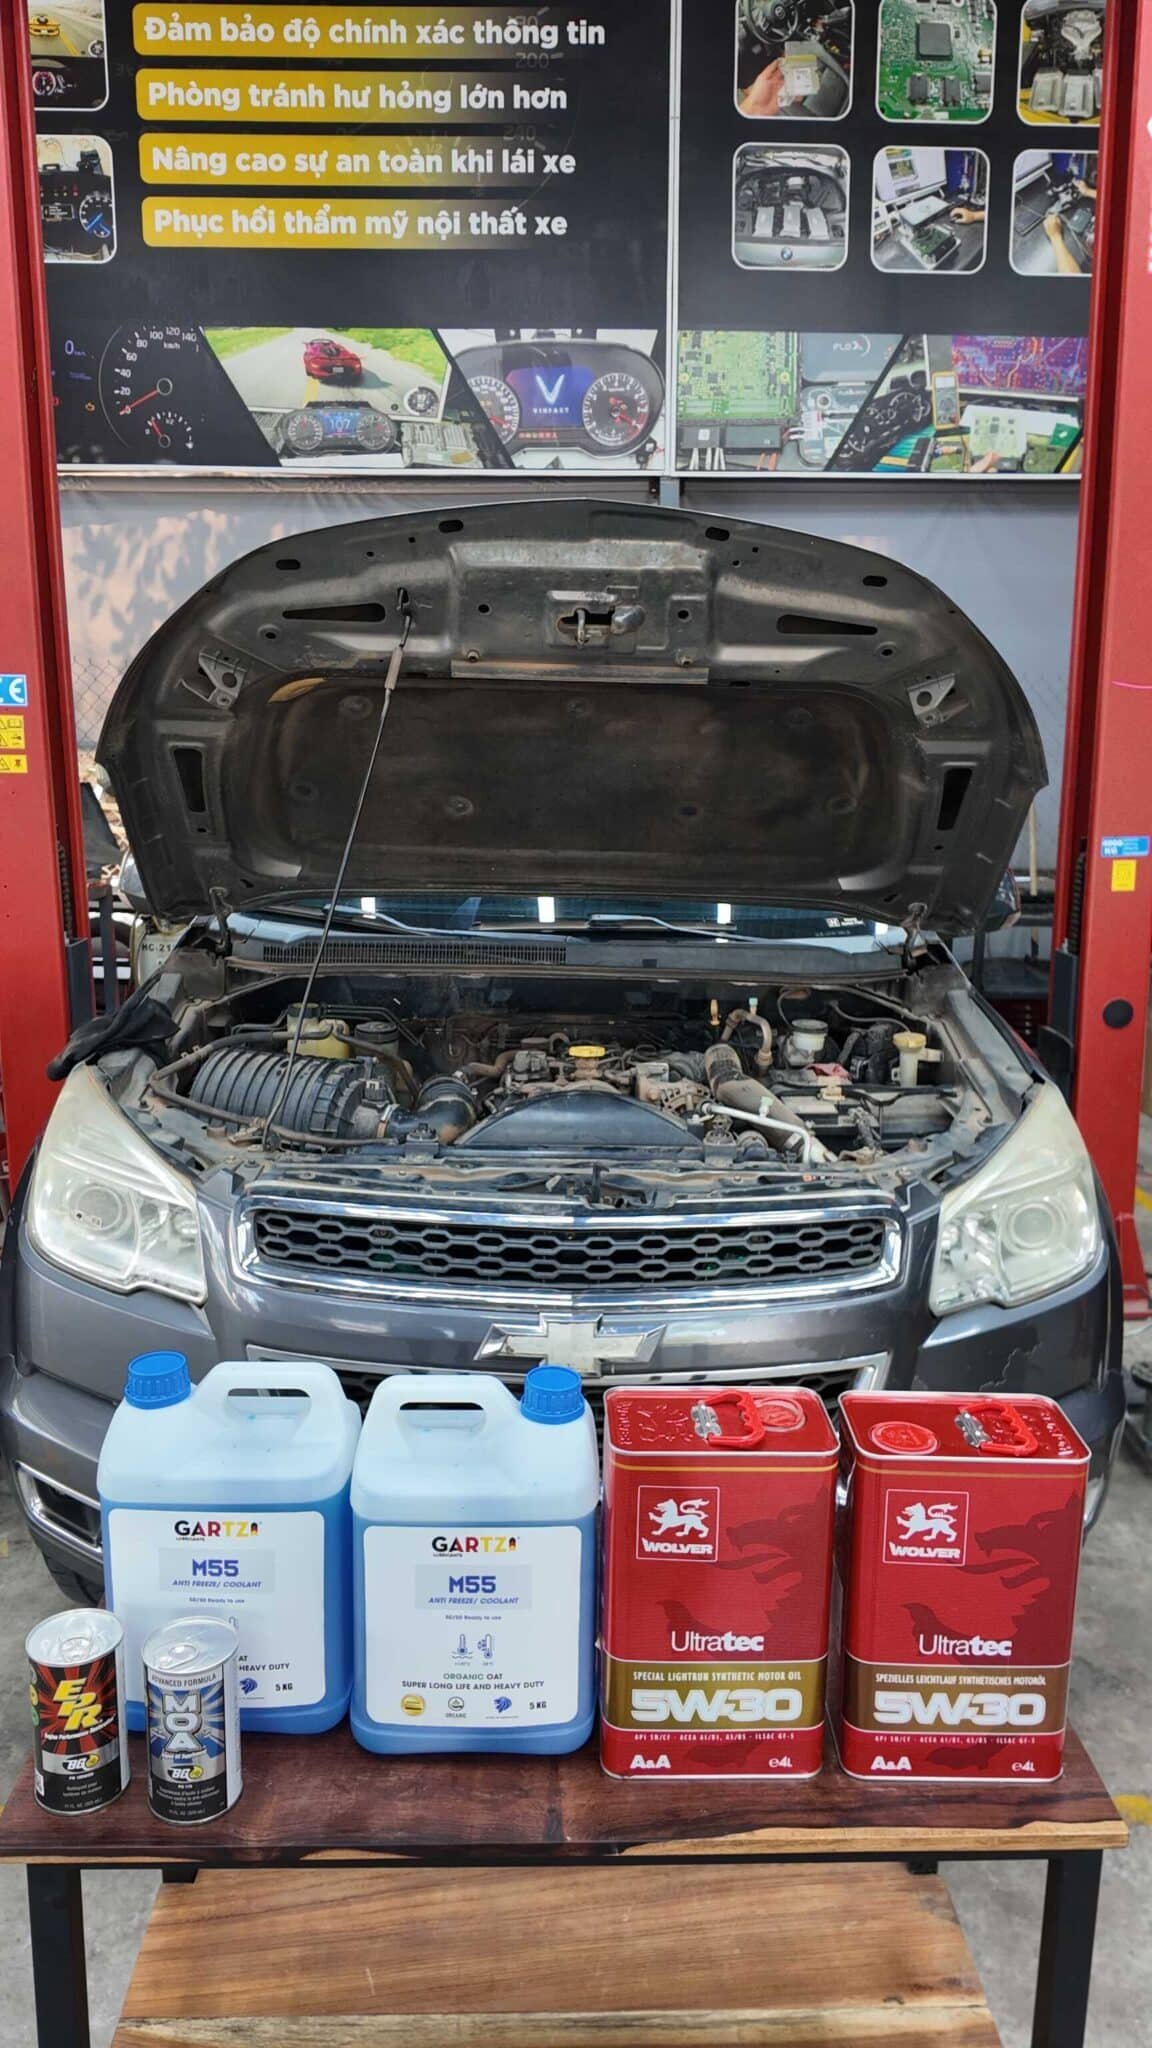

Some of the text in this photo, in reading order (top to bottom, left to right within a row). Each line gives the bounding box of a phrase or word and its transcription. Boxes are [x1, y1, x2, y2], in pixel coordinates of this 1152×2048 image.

[143, 12, 212, 41] Đảm
[220, 13, 275, 42] bảo
[283, 17, 321, 49] độ
[329, 18, 407, 44] chính
[415, 19, 465, 44] xác
[473, 19, 559, 49] thông
[567, 20, 606, 45] tin
[148, 80, 567, 114] Phòng tránh hư hỏng lớn hơn
[152, 145, 577, 178] Nâng cao sự an toàn khi lái xe
[154, 203, 568, 241] Phục hồi thẩm mỹ nội thất xe
[150, 331, 163, 340] 100
[166, 327, 180, 336] 120
[182, 332, 197, 342] 140
[136, 339, 148, 348] 80
[126, 352, 138, 362] 60
[120, 369, 132, 378] 40
[120, 387, 131, 396] 20
[641, 1537, 713, 1555] WOLVER
[888, 1541, 961, 1559] WOLVER
[192, 1558, 239, 1577] M55
[172, 1579, 190, 1587] ANTI
[448, 1575, 497, 1594] M55
[671, 1630, 764, 1652] Ultratec
[919, 1634, 1012, 1656] Ultratec
[239, 1662, 290, 1672] HEAVY DUTY
[184, 1673, 217, 1687] FORMULA
[443, 1673, 484, 1681] ORGANIC
[633, 1671, 802, 1681] SPECIAL LIGHTRUN SYNTHETIC MOTOR OIL
[875, 1673, 1047, 1686] SPEZIELLES LEICHTLAUF SYNTHETISCHES MOTORÖL
[275, 1682, 293, 1691] 5 KG
[401, 1680, 427, 1689] SUPER
[429, 1682, 453, 1690] LONG
[494, 1682, 521, 1690] HEAVY
[523, 1680, 545, 1689] DUTY
[53, 1677, 103, 1731] EPR
[529, 1701, 547, 1710] 5 KG
[630, 1688, 803, 1722] 5W-30
[873, 1690, 1047, 1726] 5W-30
[163, 1693, 202, 1751] MOA
